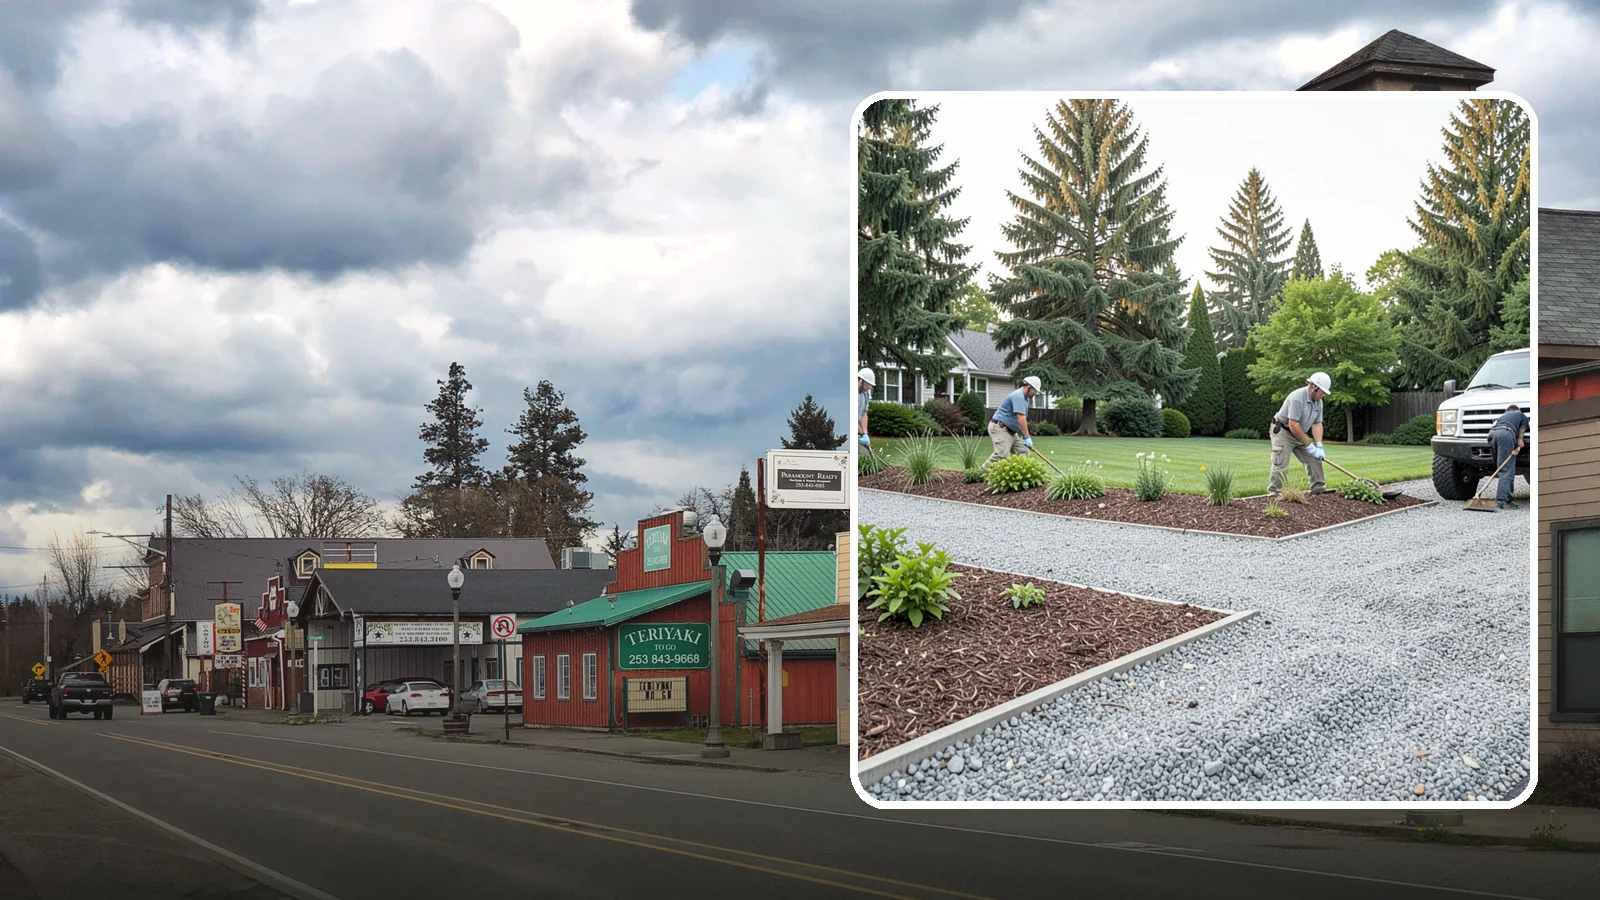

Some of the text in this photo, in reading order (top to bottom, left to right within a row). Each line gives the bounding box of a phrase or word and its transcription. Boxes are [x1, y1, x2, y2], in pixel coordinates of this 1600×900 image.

[624, 627, 703, 646] TERIYAKI
[628, 653, 700, 665] 253 843-9668
